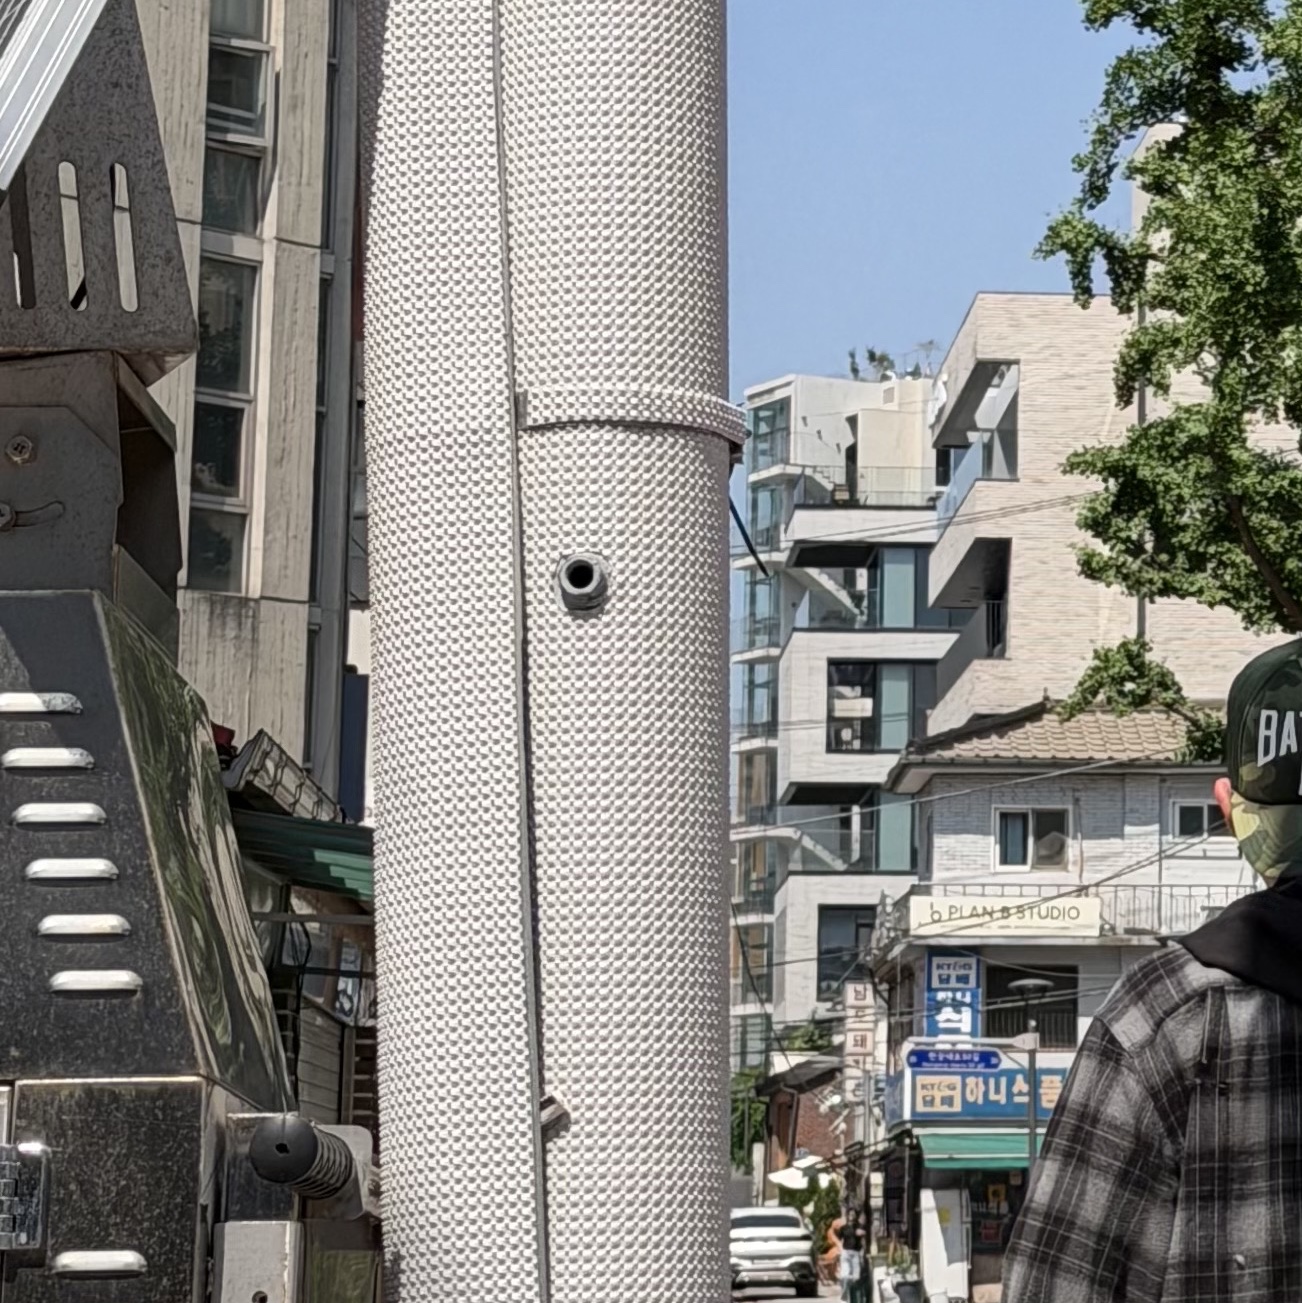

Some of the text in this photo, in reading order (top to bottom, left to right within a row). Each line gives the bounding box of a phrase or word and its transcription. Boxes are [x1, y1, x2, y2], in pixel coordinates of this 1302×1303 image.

[949, 905, 994, 920] PLAN
[1000, 906, 1012, 919] B
[1016, 905, 1081, 920] STUDIO
